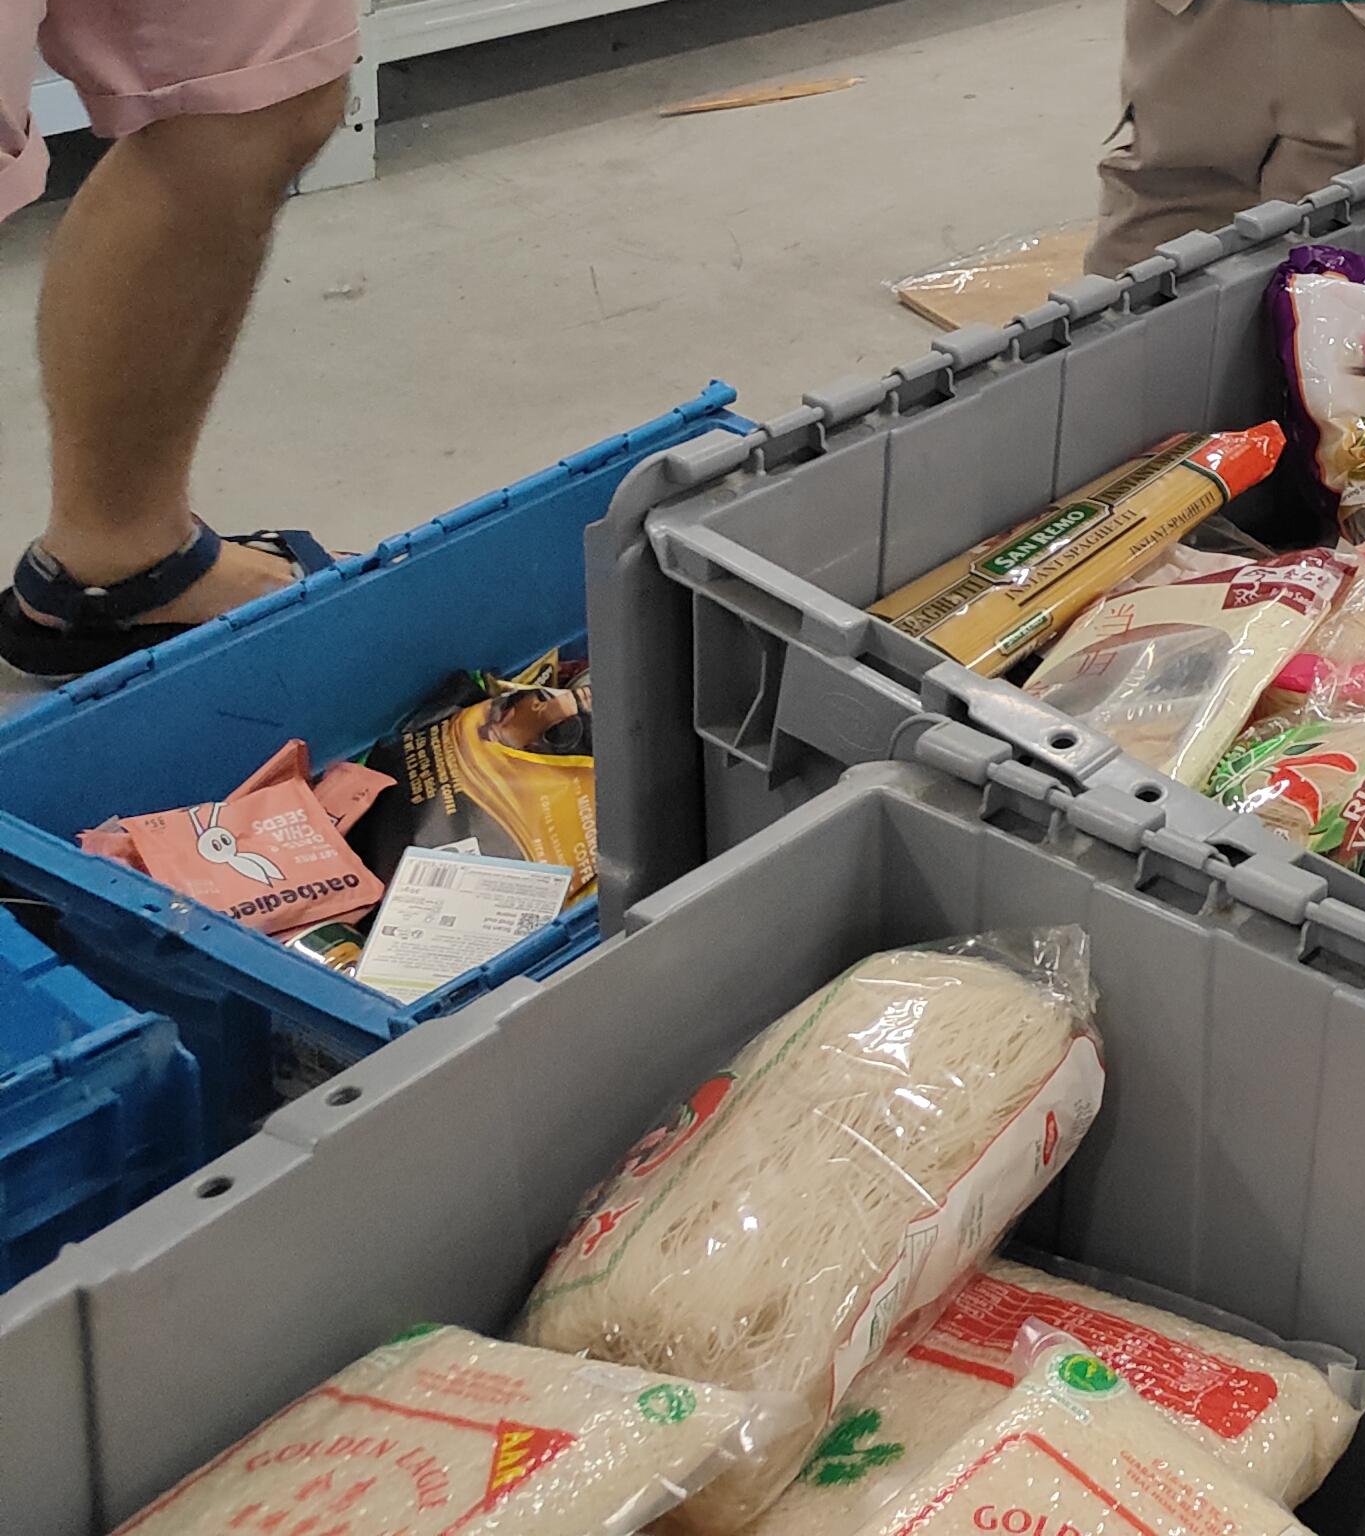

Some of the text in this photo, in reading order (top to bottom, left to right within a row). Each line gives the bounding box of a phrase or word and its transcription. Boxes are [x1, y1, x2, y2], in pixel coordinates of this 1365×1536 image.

[1167, 491, 1217, 530] SPAGHETTI
[995, 510, 1086, 569] SAN REMO
[1005, 509, 1138, 602] INSTANT SPAGHETTI
[440, 784, 457, 815] COFFEE
[252, 808, 308, 834] SEEDS
[273, 823, 316, 845] CHIA
[245, 1435, 400, 1472] GOLDEN
